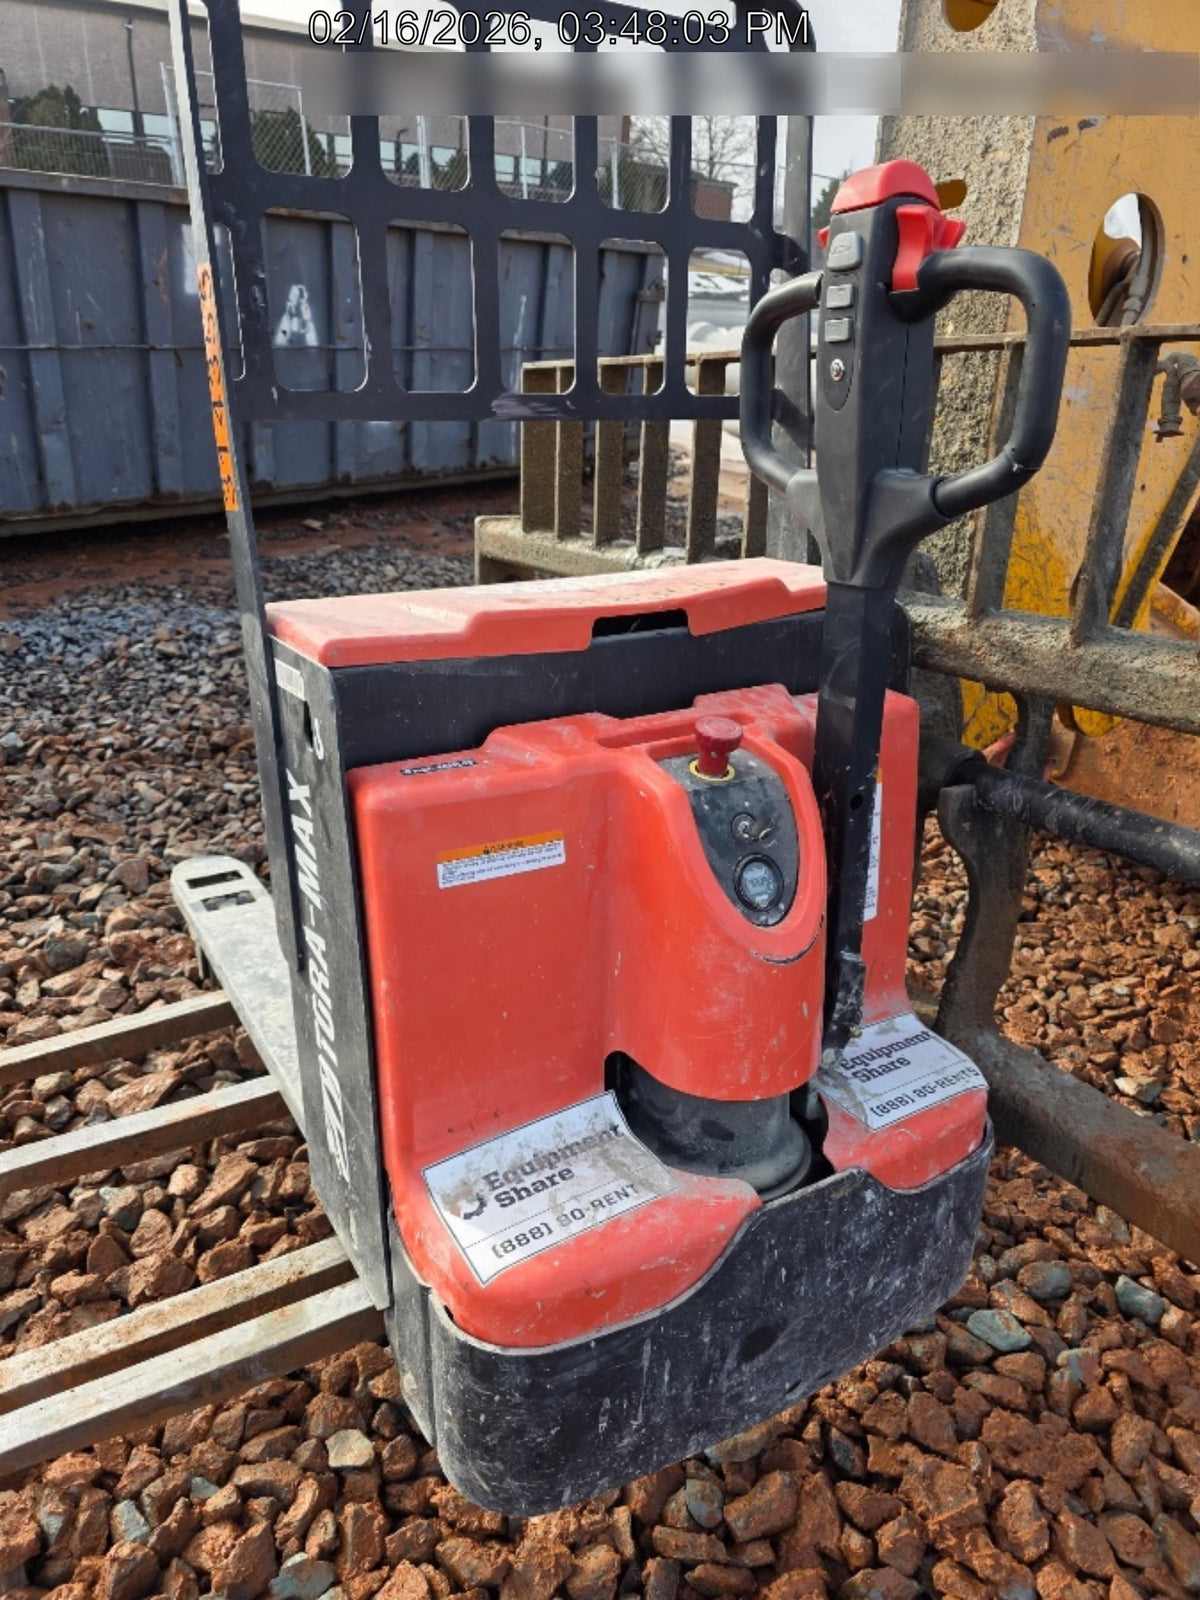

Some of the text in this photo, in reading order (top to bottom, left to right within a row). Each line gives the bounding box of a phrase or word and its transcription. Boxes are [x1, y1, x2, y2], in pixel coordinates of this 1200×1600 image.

[286, 768, 339, 1068] TORA-MAX
[840, 1030, 933, 1070] Equipment
[852, 1056, 911, 1083] Share
[870, 1093, 915, 1117] (888)
[481, 1123, 625, 1192] Equipment
[494, 1167, 575, 1208] Share
[492, 1222, 553, 1259] (888)
